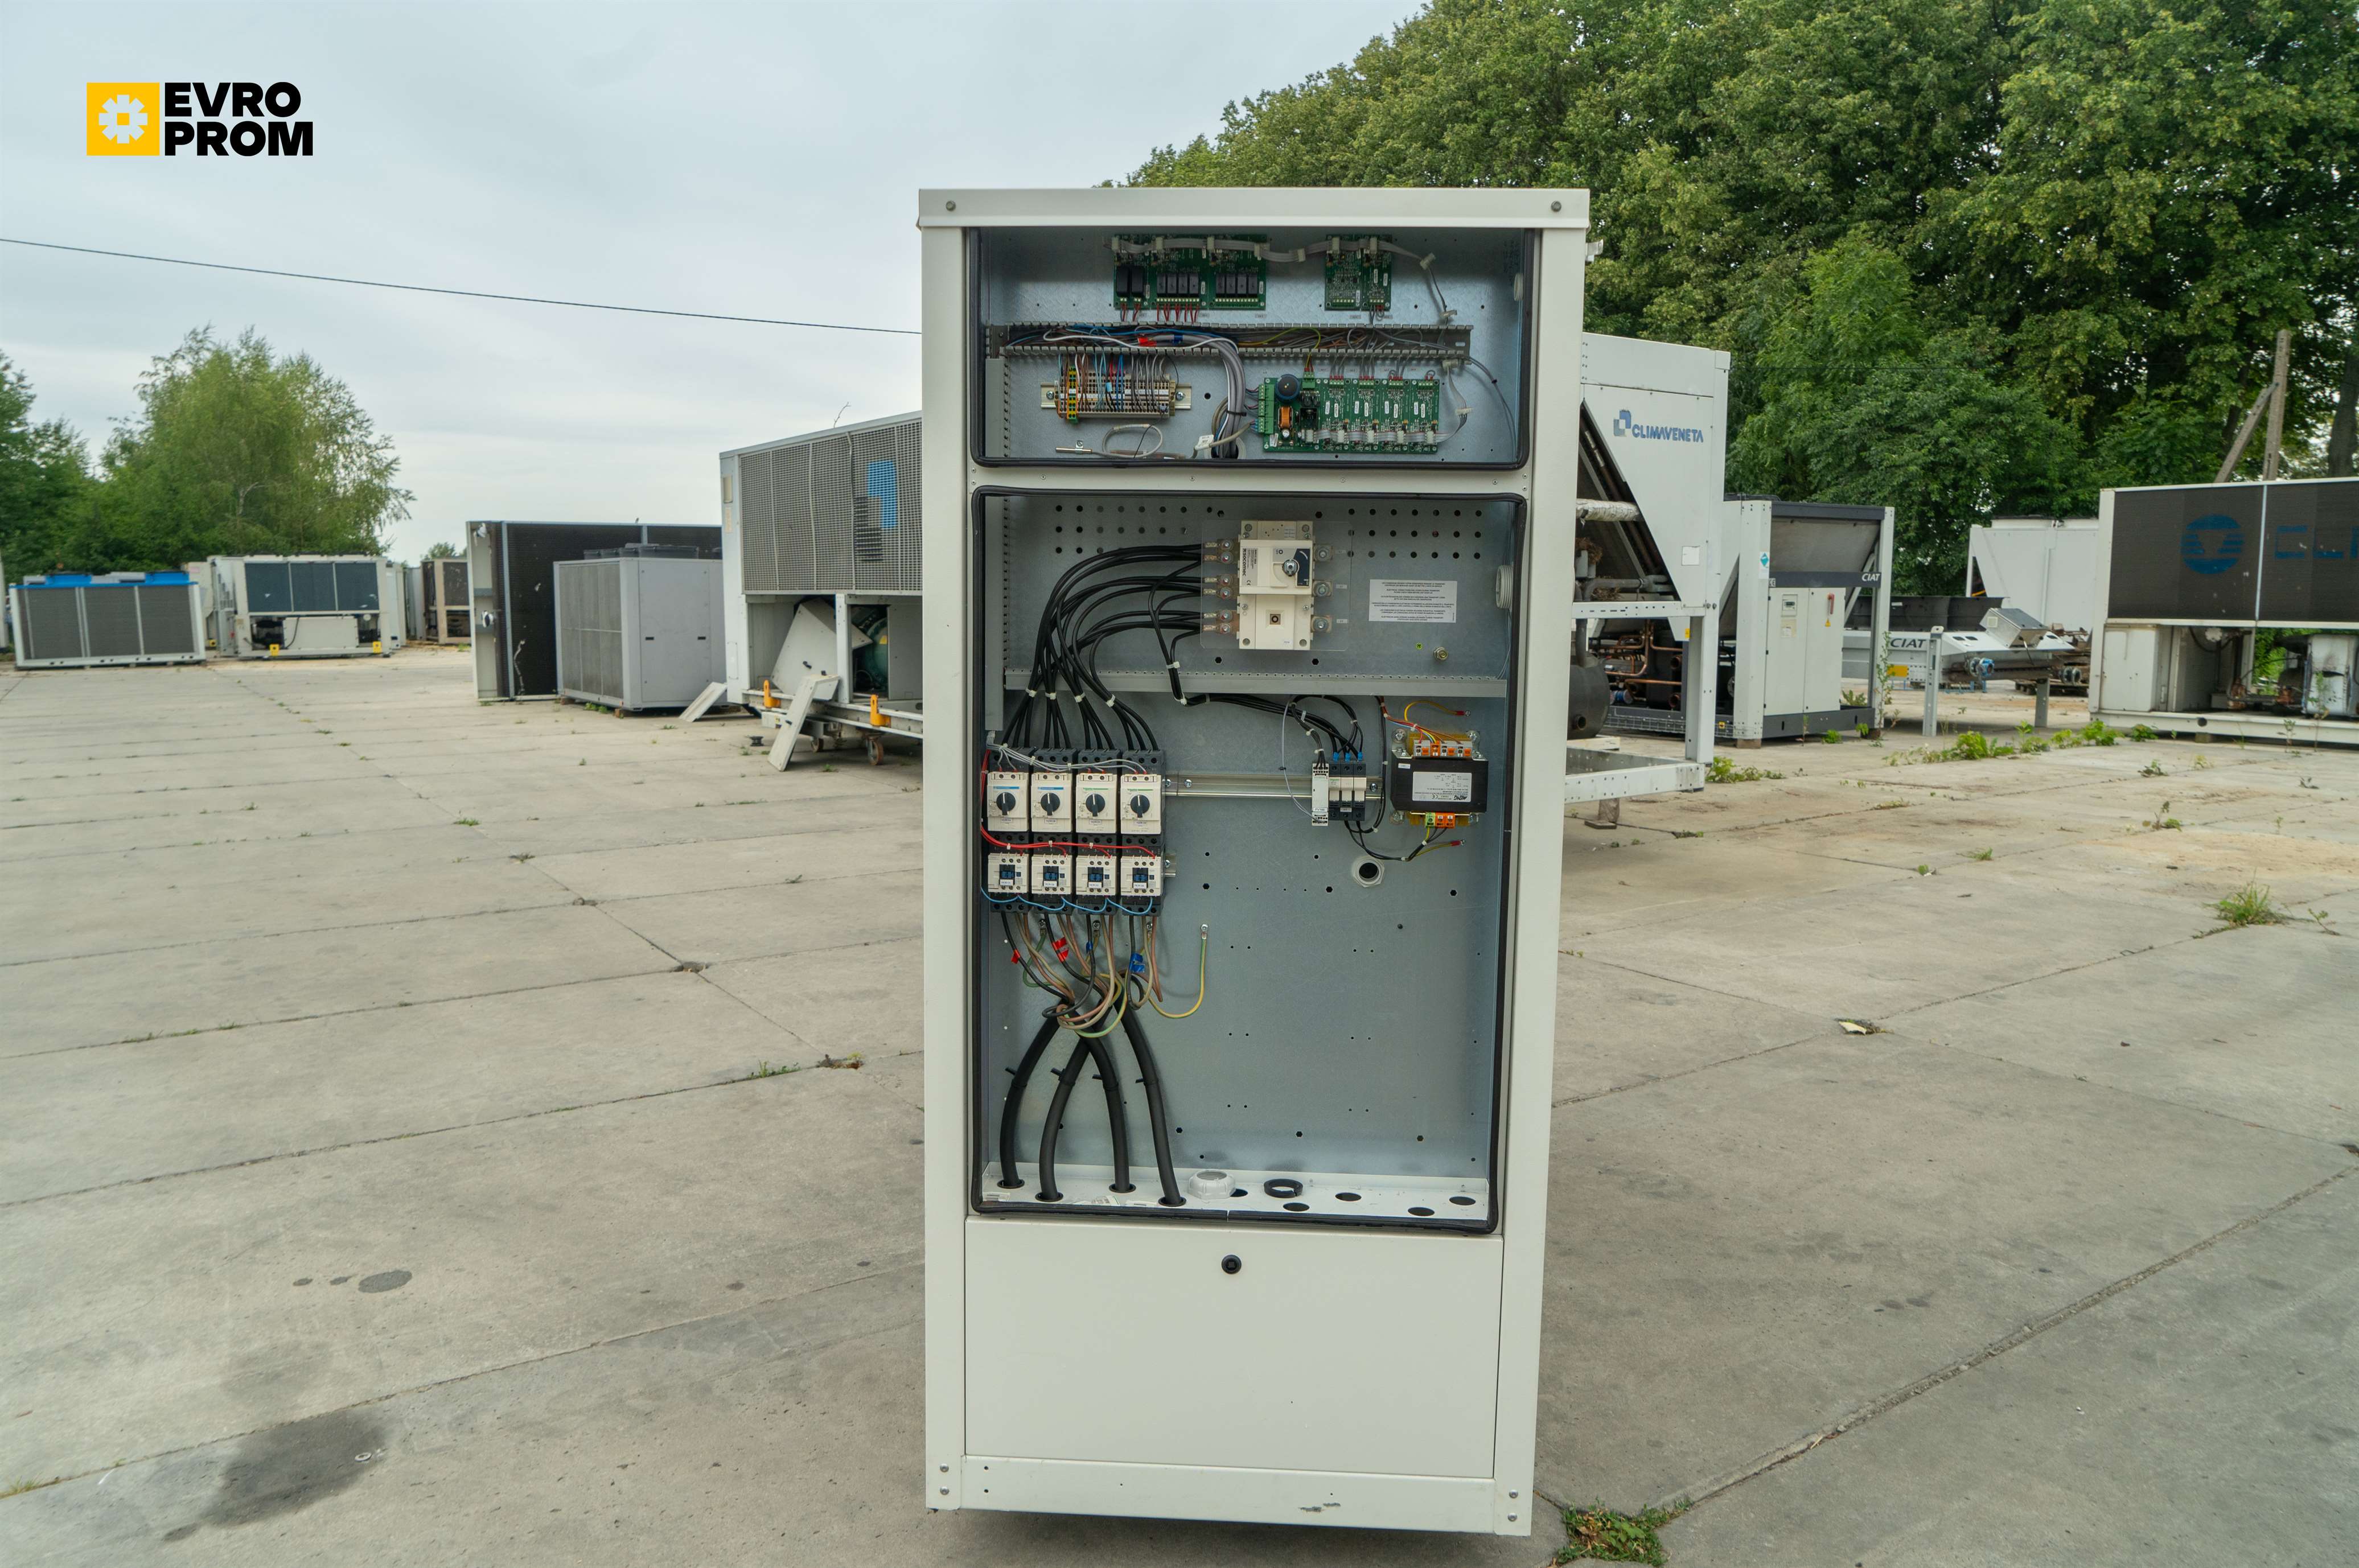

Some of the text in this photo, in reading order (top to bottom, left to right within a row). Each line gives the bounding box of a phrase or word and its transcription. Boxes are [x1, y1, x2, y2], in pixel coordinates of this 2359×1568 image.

[1631, 424, 1704, 443] CLIMAVENETA
[1861, 573, 1880, 582] CIAT
[1890, 638, 1926, 648] CIAT
